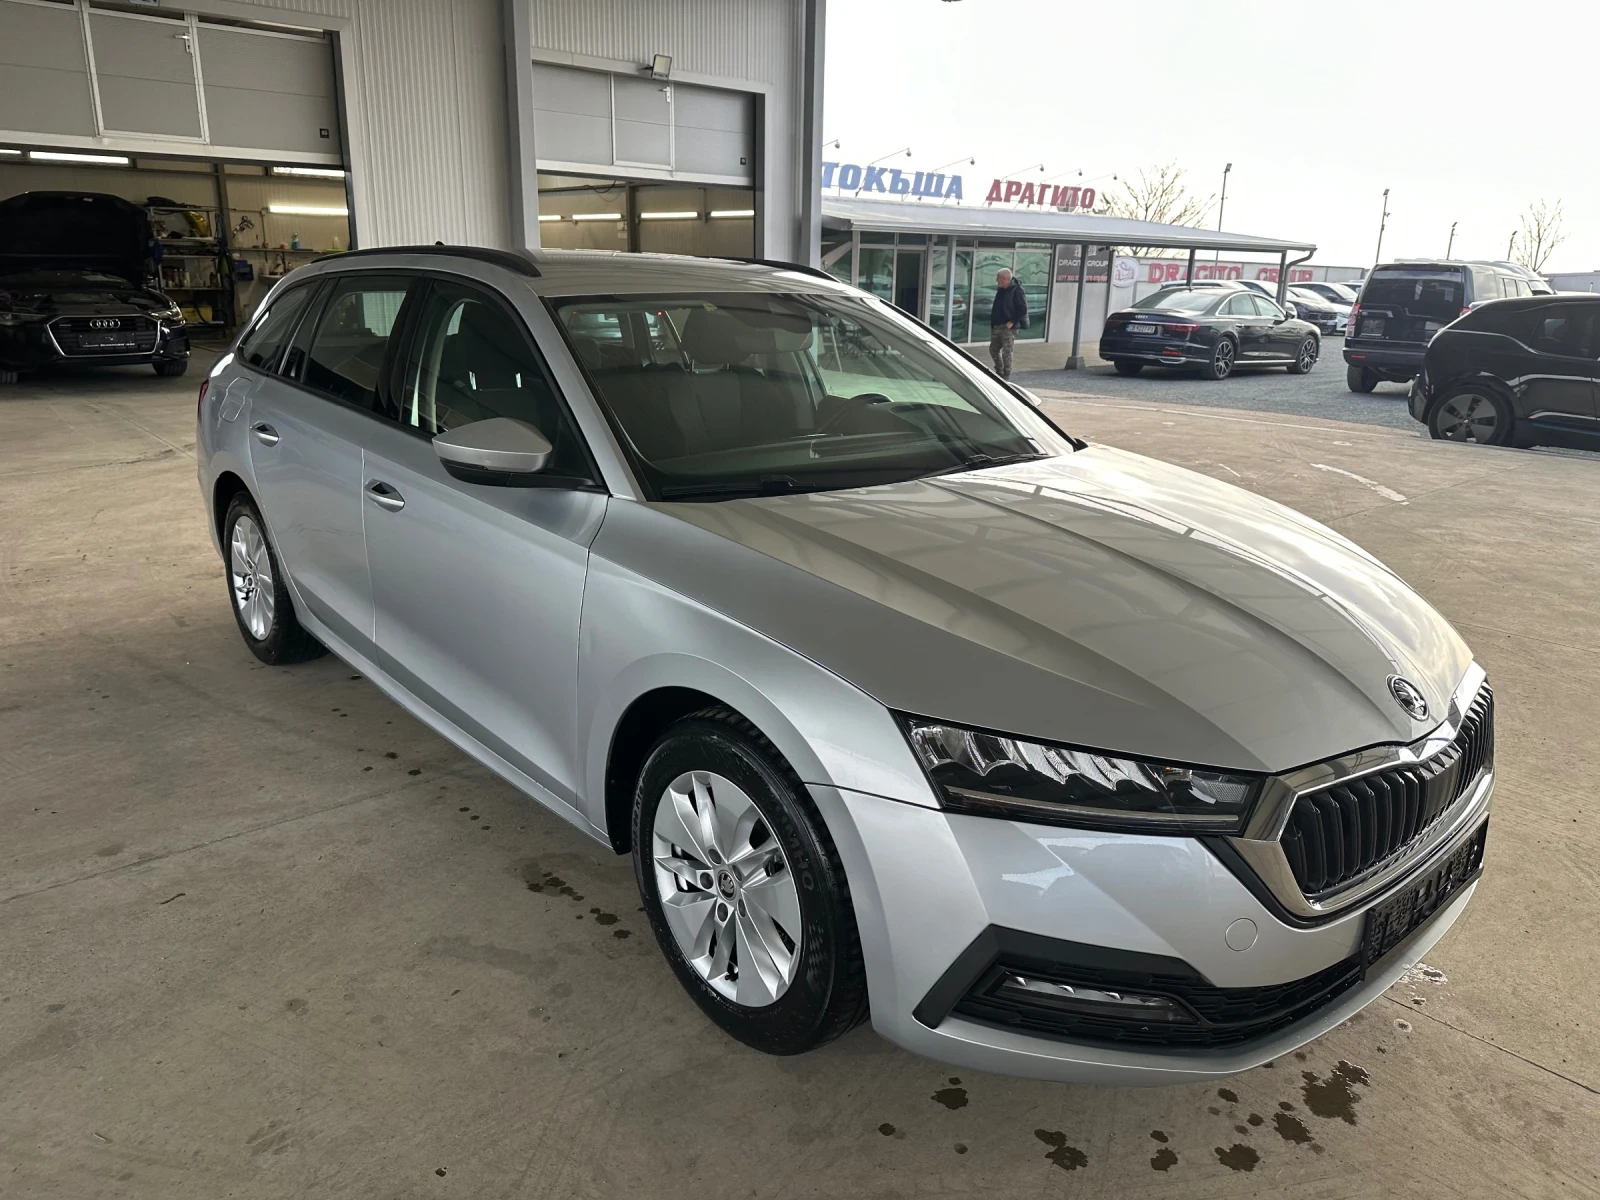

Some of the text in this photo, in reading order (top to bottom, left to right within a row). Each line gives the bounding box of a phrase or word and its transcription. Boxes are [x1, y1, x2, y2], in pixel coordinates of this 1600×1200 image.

[985, 179, 1096, 209] ДРАГИТО
[1149, 263, 1314, 283] DRGITO GRUP
